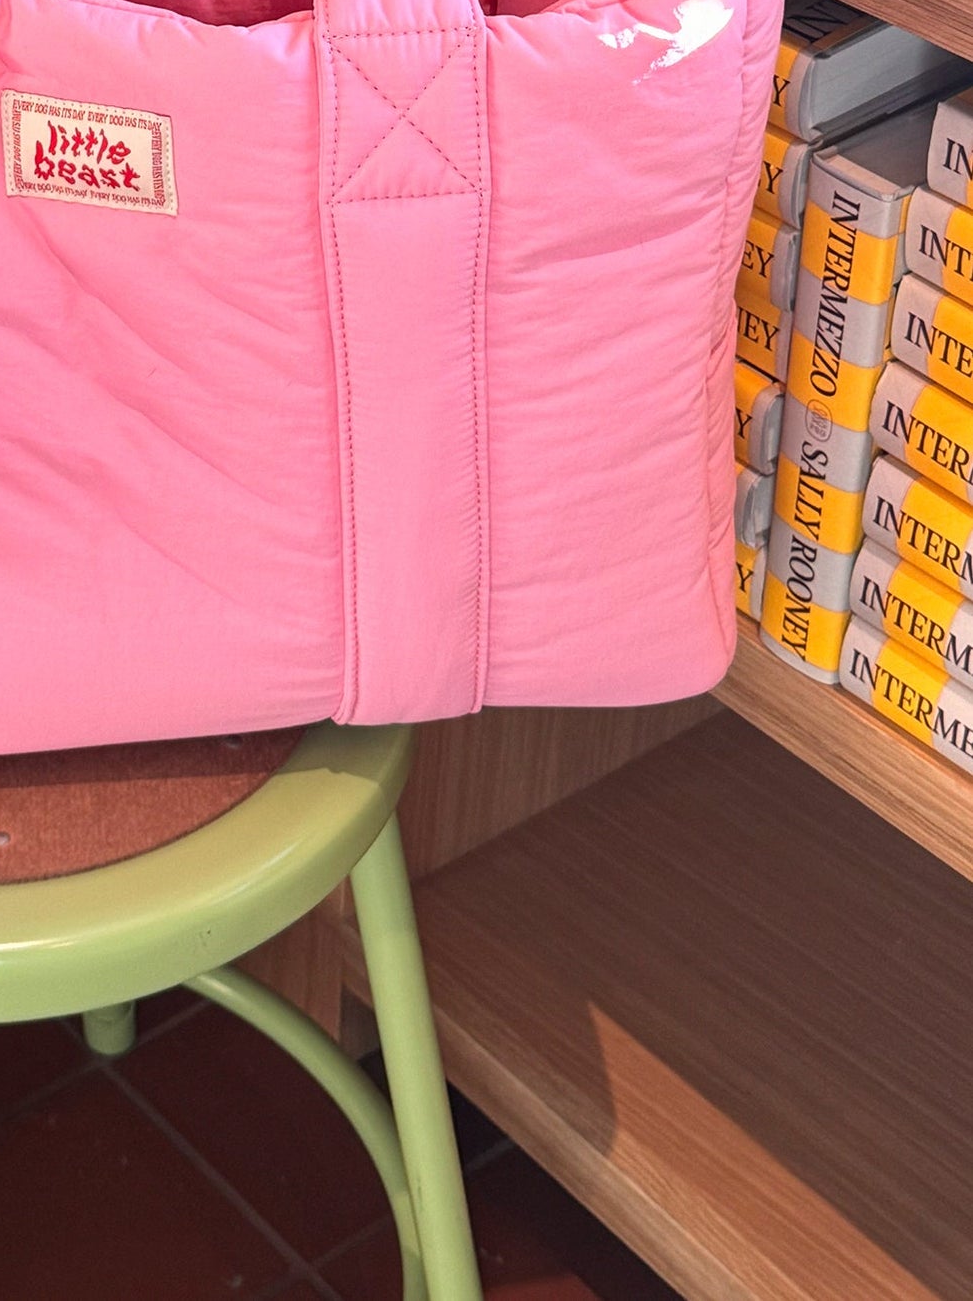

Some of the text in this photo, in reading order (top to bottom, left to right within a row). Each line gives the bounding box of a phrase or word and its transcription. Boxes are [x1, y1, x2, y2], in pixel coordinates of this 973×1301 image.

[34, 140, 141, 192] beast
[47, 120, 131, 165] little
[809, 190, 861, 398] INTERMEZZO
[882, 400, 973, 484] INTER
[794, 441, 828, 544] SALLY
[781, 536, 817, 662] ROONEY
